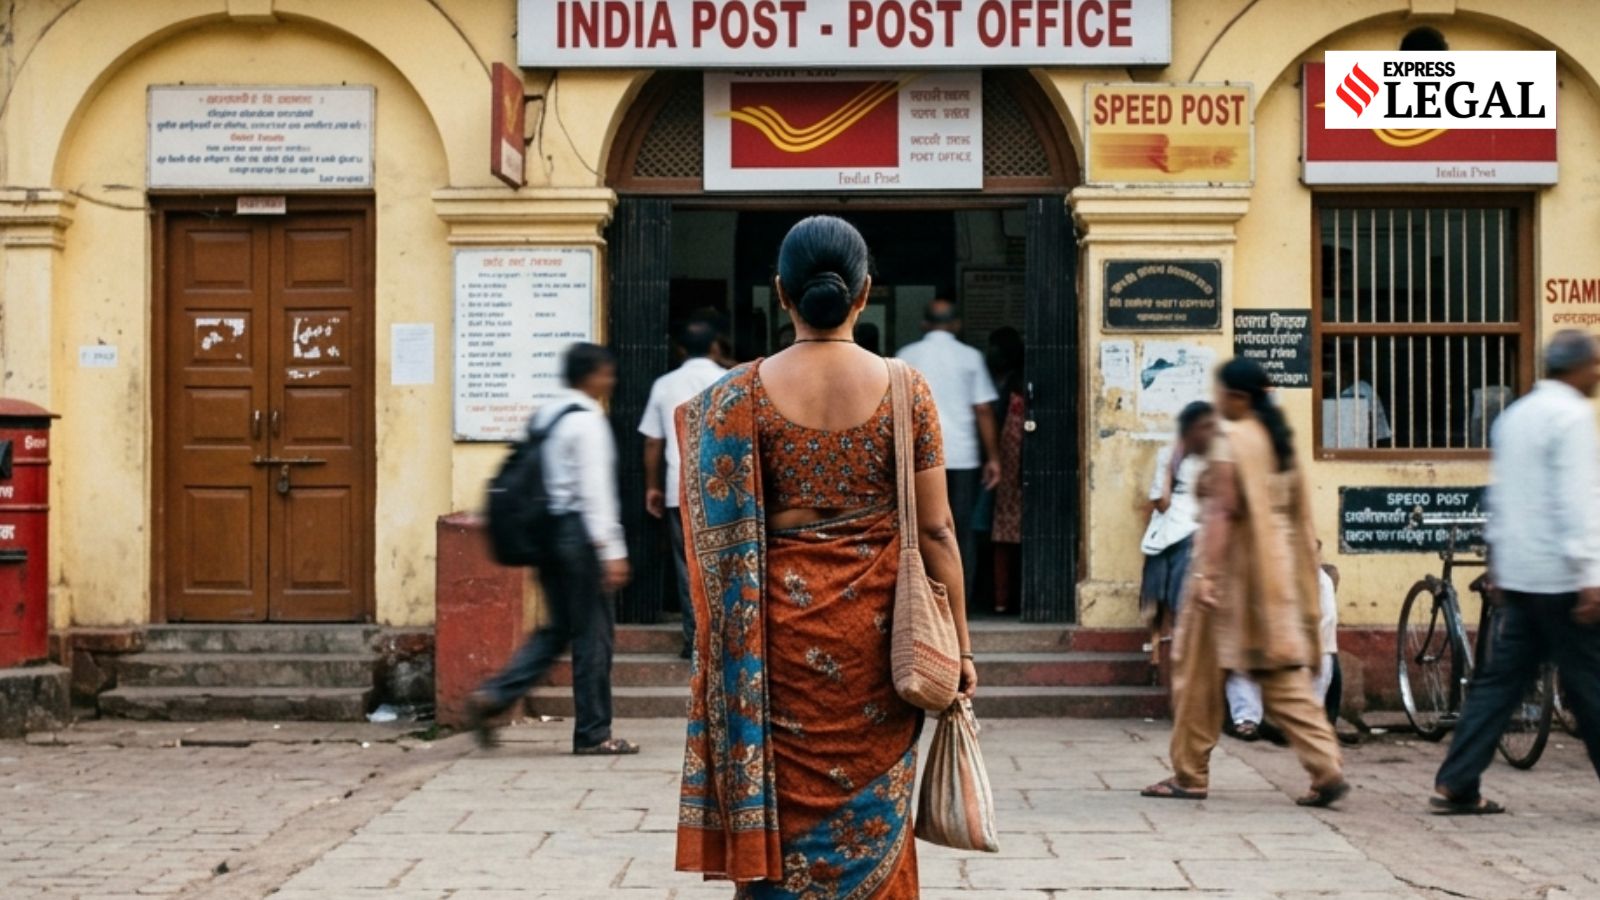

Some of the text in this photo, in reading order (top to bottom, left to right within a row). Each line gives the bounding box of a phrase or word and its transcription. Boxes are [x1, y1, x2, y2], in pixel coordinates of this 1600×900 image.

[557, 0, 1133, 49] INDIA POST - POST OFFICE
[1094, 94, 1245, 126] SPEED POST
[1436, 493, 1469, 506] POST
